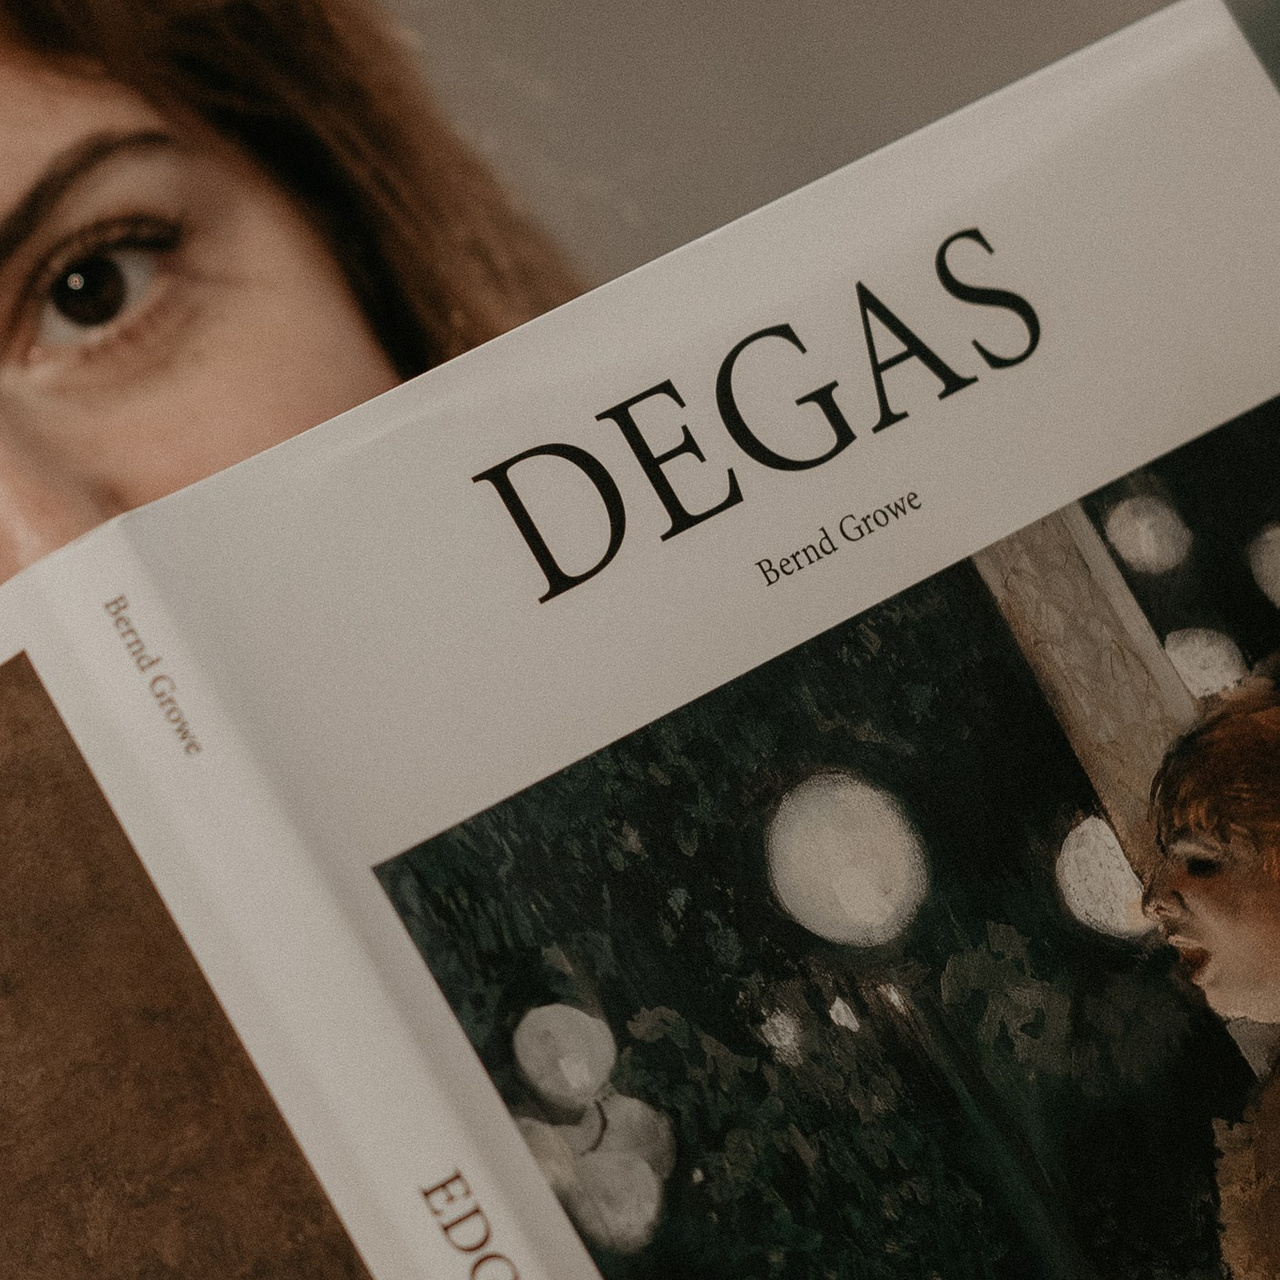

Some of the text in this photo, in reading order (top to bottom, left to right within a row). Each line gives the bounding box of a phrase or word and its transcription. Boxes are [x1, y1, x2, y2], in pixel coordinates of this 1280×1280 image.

[472, 227, 1041, 604] DEGAS
[754, 491, 922, 587] Bernd Growe
[104, 594, 201, 754] Bernd Growe
